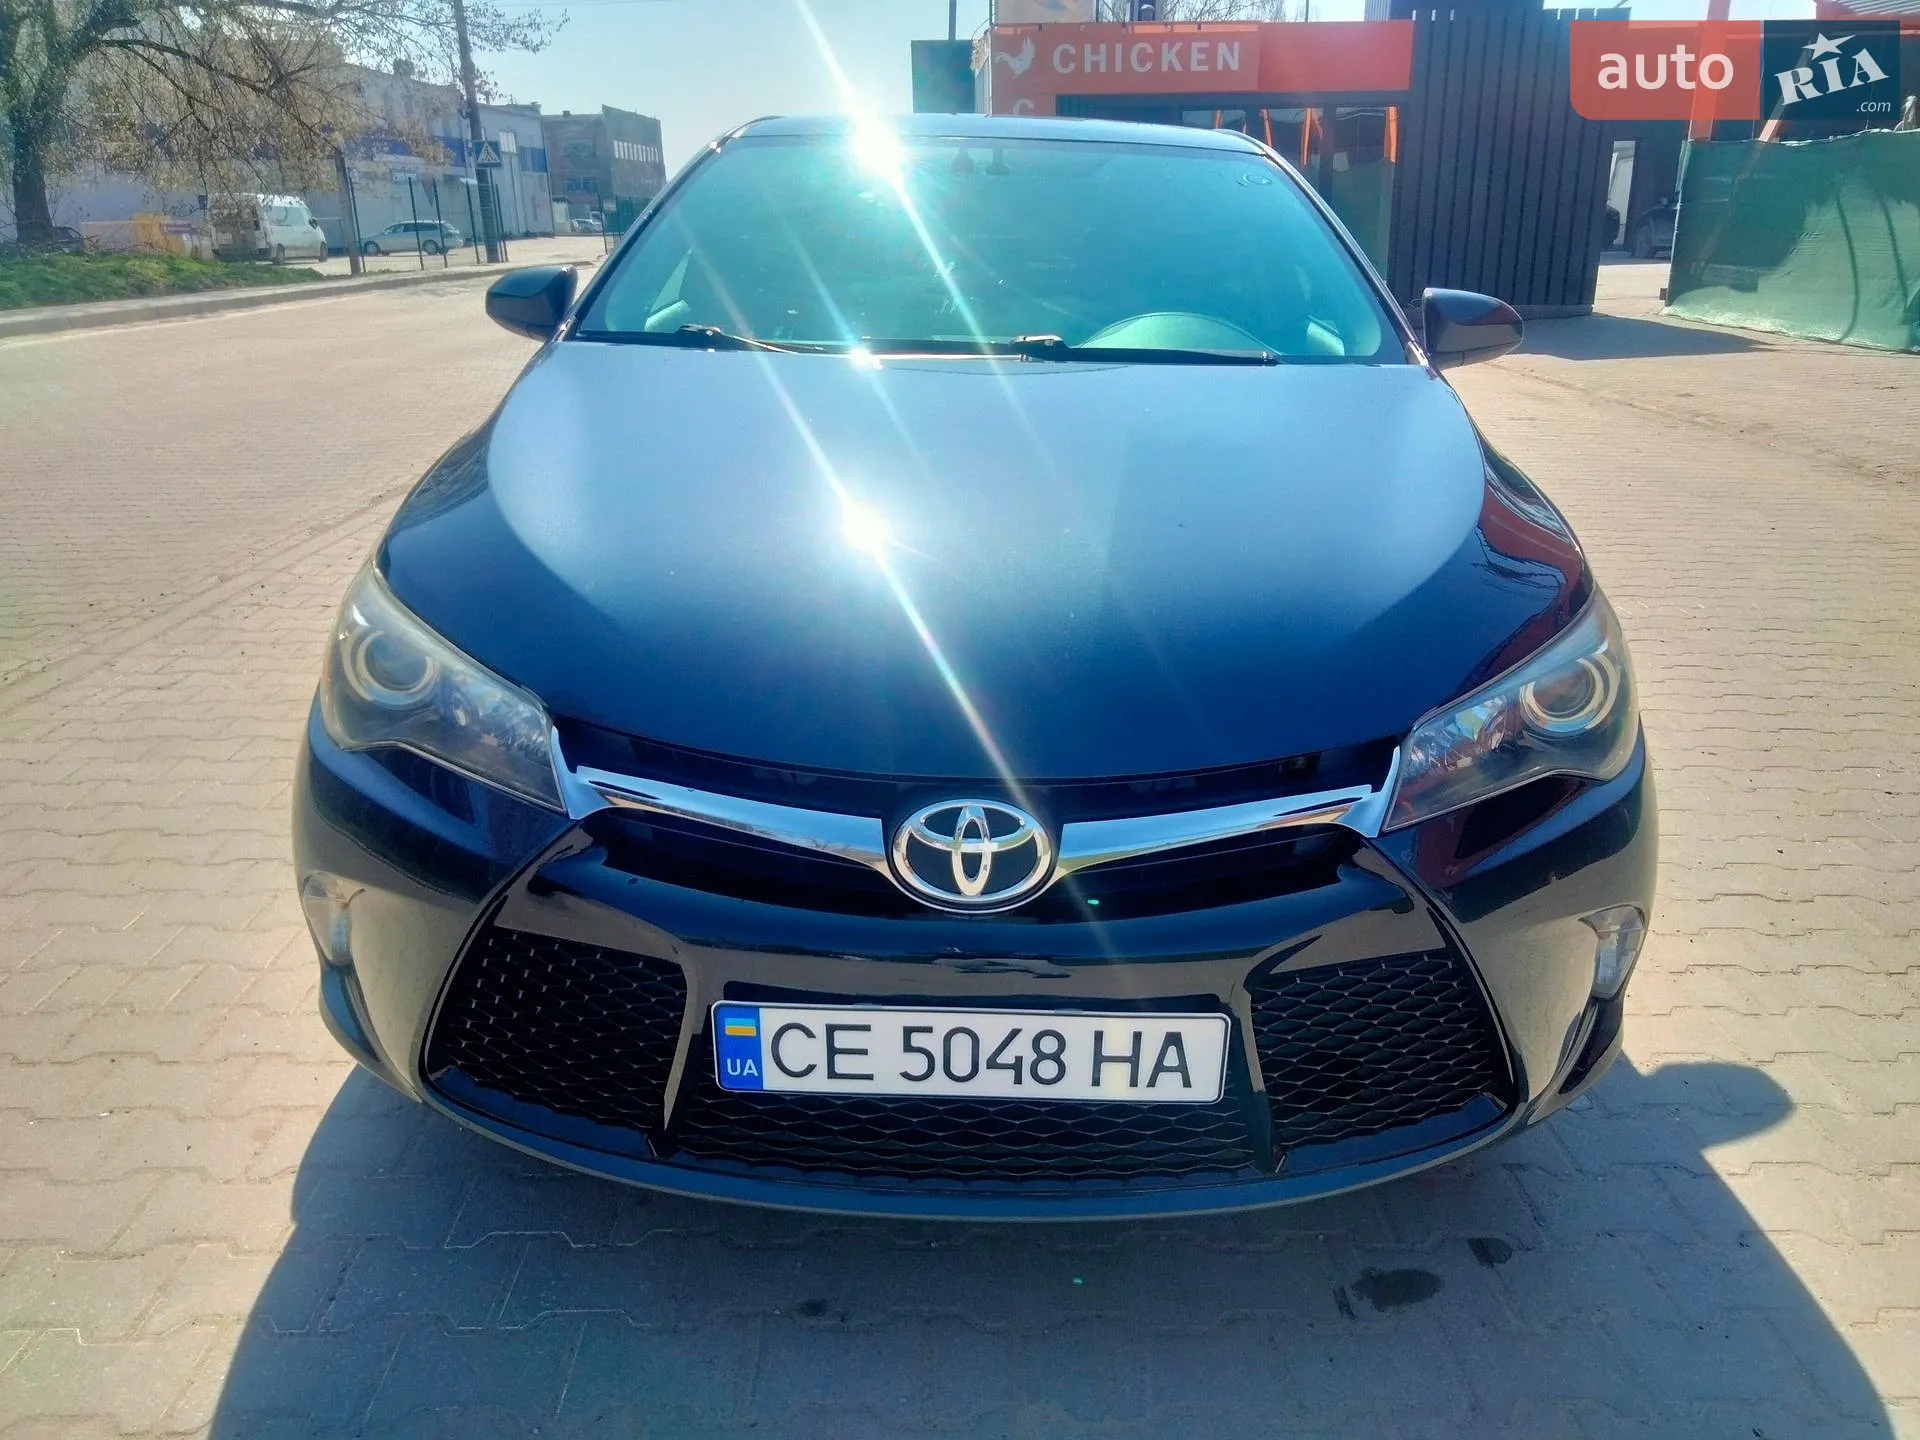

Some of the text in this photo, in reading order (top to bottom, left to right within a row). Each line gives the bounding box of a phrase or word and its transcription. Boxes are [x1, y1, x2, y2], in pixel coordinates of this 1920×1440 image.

[1053, 42, 1240, 74] CHICKEN
[727, 1058, 759, 1077] UA
[771, 1022, 1192, 1088] CE 5048 HA
